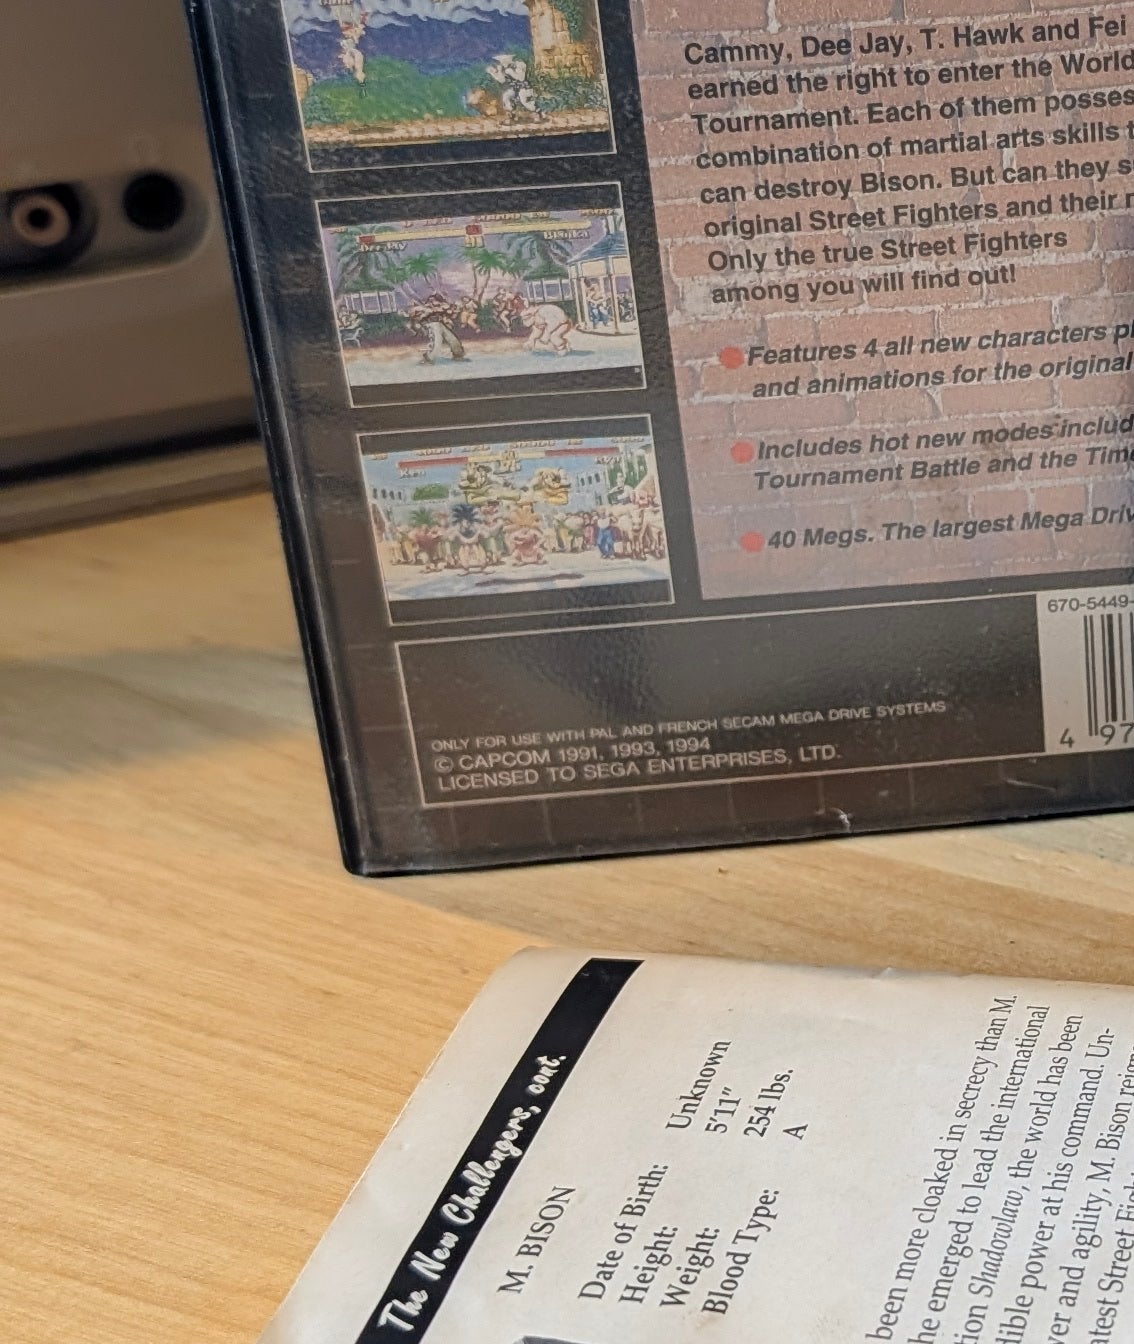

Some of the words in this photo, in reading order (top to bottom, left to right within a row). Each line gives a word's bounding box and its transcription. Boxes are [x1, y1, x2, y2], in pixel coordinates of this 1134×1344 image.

[684, 42, 792, 70] Cammy,
[800, 34, 851, 59] Dee
[858, 31, 912, 57] Jay,
[919, 27, 944, 49] T.
[953, 22, 1024, 47] Hawk
[1031, 17, 1079, 42] and
[1088, 14, 1126, 38] Fei
[707, 248, 767, 274] Only
[774, 246, 815, 270] the
[821, 243, 873, 266] true
[880, 231, 956, 262] Street
[963, 230, 1067, 257] Fighters
[747, 343, 856, 366] Features
[862, 338, 878, 357] 4
[884, 335, 913, 356] all
[919, 334, 972, 354] new
[977, 324, 1107, 349] characters
[767, 530, 796, 548] 40
[802, 527, 873, 548] Megs.
[881, 521, 926, 540] The
[932, 513, 1014, 539] largest
[1020, 510, 1083, 532] Mega
[431, 738, 469, 751] ONLY
[475, 735, 506, 747] FOR
[511, 732, 540, 745] USE
[546, 729, 585, 742] WITH
[589, 727, 616, 738] PAL
[622, 723, 653, 737] AND
[657, 719, 717, 733] FRENCH
[722, 714, 775, 729] SECAM
[779, 710, 824, 724] MEGA
[828, 706, 871, 720] DRIVE
[876, 700, 946, 717] SYSTEMS
[437, 768, 538, 791] LICENSED
[546, 765, 576, 781] TO
[583, 760, 640, 779] SEGA
[646, 748, 792, 774] ENTERPRISES,
[799, 744, 840, 761] LTD.
[458, 748, 551, 771] CAPCOM
[557, 745, 605, 766] 1991,
[611, 740, 658, 762] 1993,
[664, 736, 711, 755] 1994
[988, 994, 1018, 1014] M.
[974, 1017, 1008, 1051] than
[665, 1039, 733, 1130] Unknown
[954, 1055, 995, 1118] secrecy
[939, 1123, 967, 1142] in
[376, 1289, 430, 1333] The
[409, 1231, 460, 1282] New
[440, 1105, 543, 1227] Challengers,
[527, 1054, 568, 1096] cont.
[620, 1163, 670, 1218] Birth:
[659, 1227, 721, 1308] Weight:
[743, 1105, 776, 1138] 254
[760, 1068, 794, 1102] lbs.
[911, 1148, 958, 1223] cloaked
[497, 1264, 535, 1294] M.
[516, 1185, 577, 1258] BISON
[613, 1221, 639, 1244] of
[701, 1251, 752, 1315] Blood
[732, 1188, 780, 1244] Type:
[782, 1123, 809, 1141] A
[577, 1249, 625, 1300] Date
[618, 1225, 679, 1304] Height:
[895, 1228, 929, 1280] more
[864, 1287, 907, 1340] been
